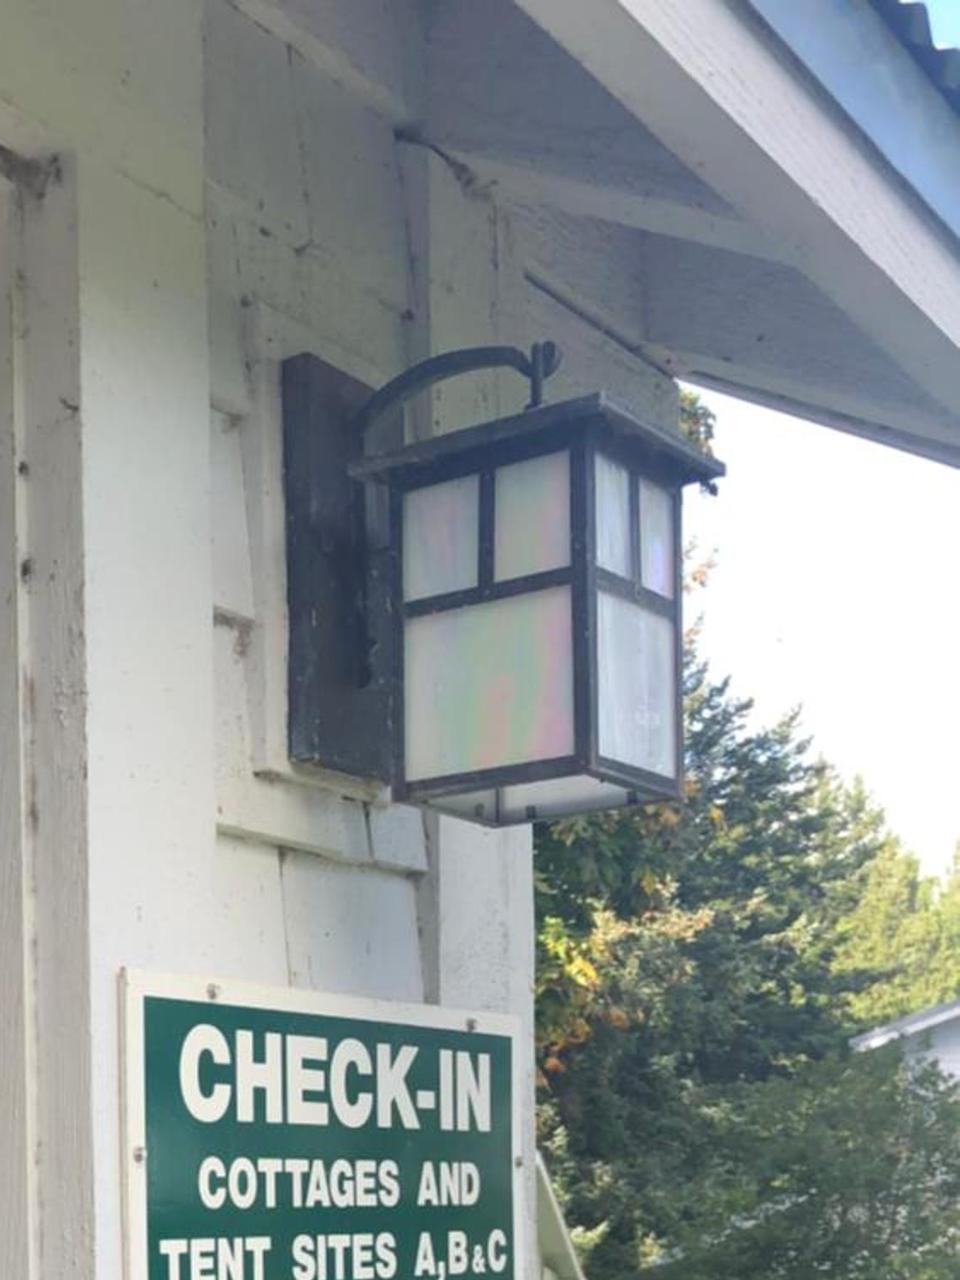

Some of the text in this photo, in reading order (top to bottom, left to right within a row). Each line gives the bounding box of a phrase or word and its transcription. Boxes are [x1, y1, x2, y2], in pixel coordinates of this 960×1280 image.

[179, 1023, 491, 1132] CHECK-IN
[198, 1156, 481, 1209] COTTAGES AND
